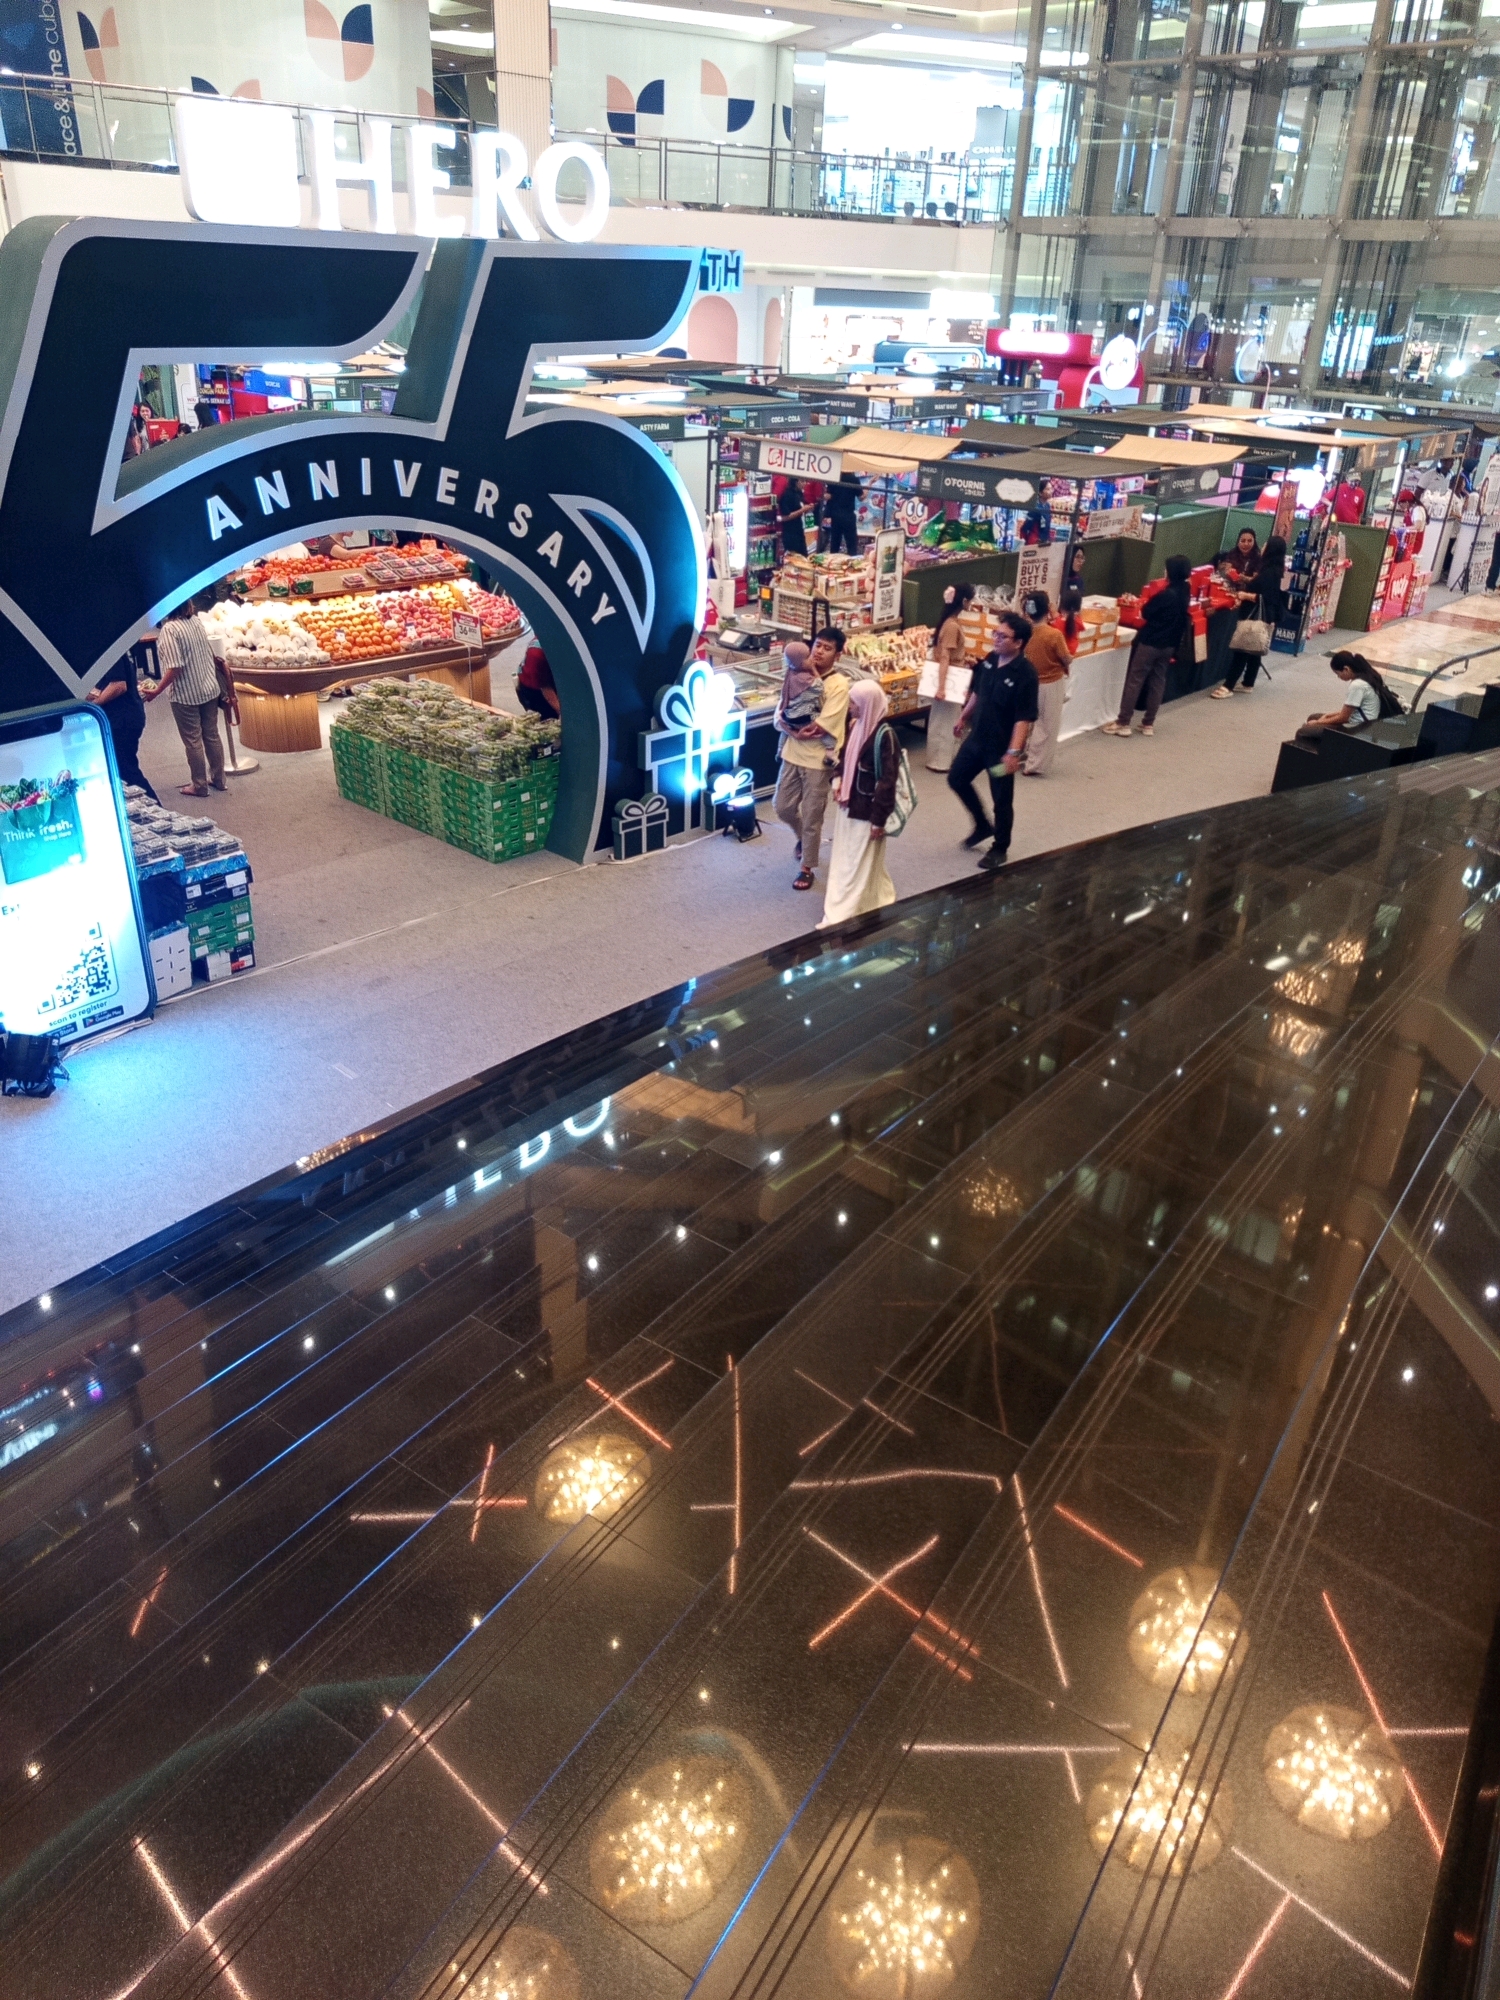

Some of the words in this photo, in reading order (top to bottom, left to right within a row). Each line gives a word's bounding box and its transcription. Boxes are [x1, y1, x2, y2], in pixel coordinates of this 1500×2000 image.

[39, 0, 59, 45] cub
[54, 98, 70, 114] &
[302, 108, 611, 243] HERO
[707, 253, 741, 288] TH
[654, 422, 670, 431] FARM
[770, 416, 785, 424] COCA
[788, 415, 801, 423] COLA
[783, 450, 833, 475] HERO
[207, 457, 617, 626] ANNIVERSARY
[1021, 564, 1041, 576] BUY
[1042, 563, 1048, 574] 6
[1020, 575, 1039, 587] GET
[1041, 574, 1047, 584] 6
[458, 625, 468, 636] 36
[3, 828, 36, 843] Think
[68, 1012, 78, 1020] to
[78, 1001, 108, 1016] register
